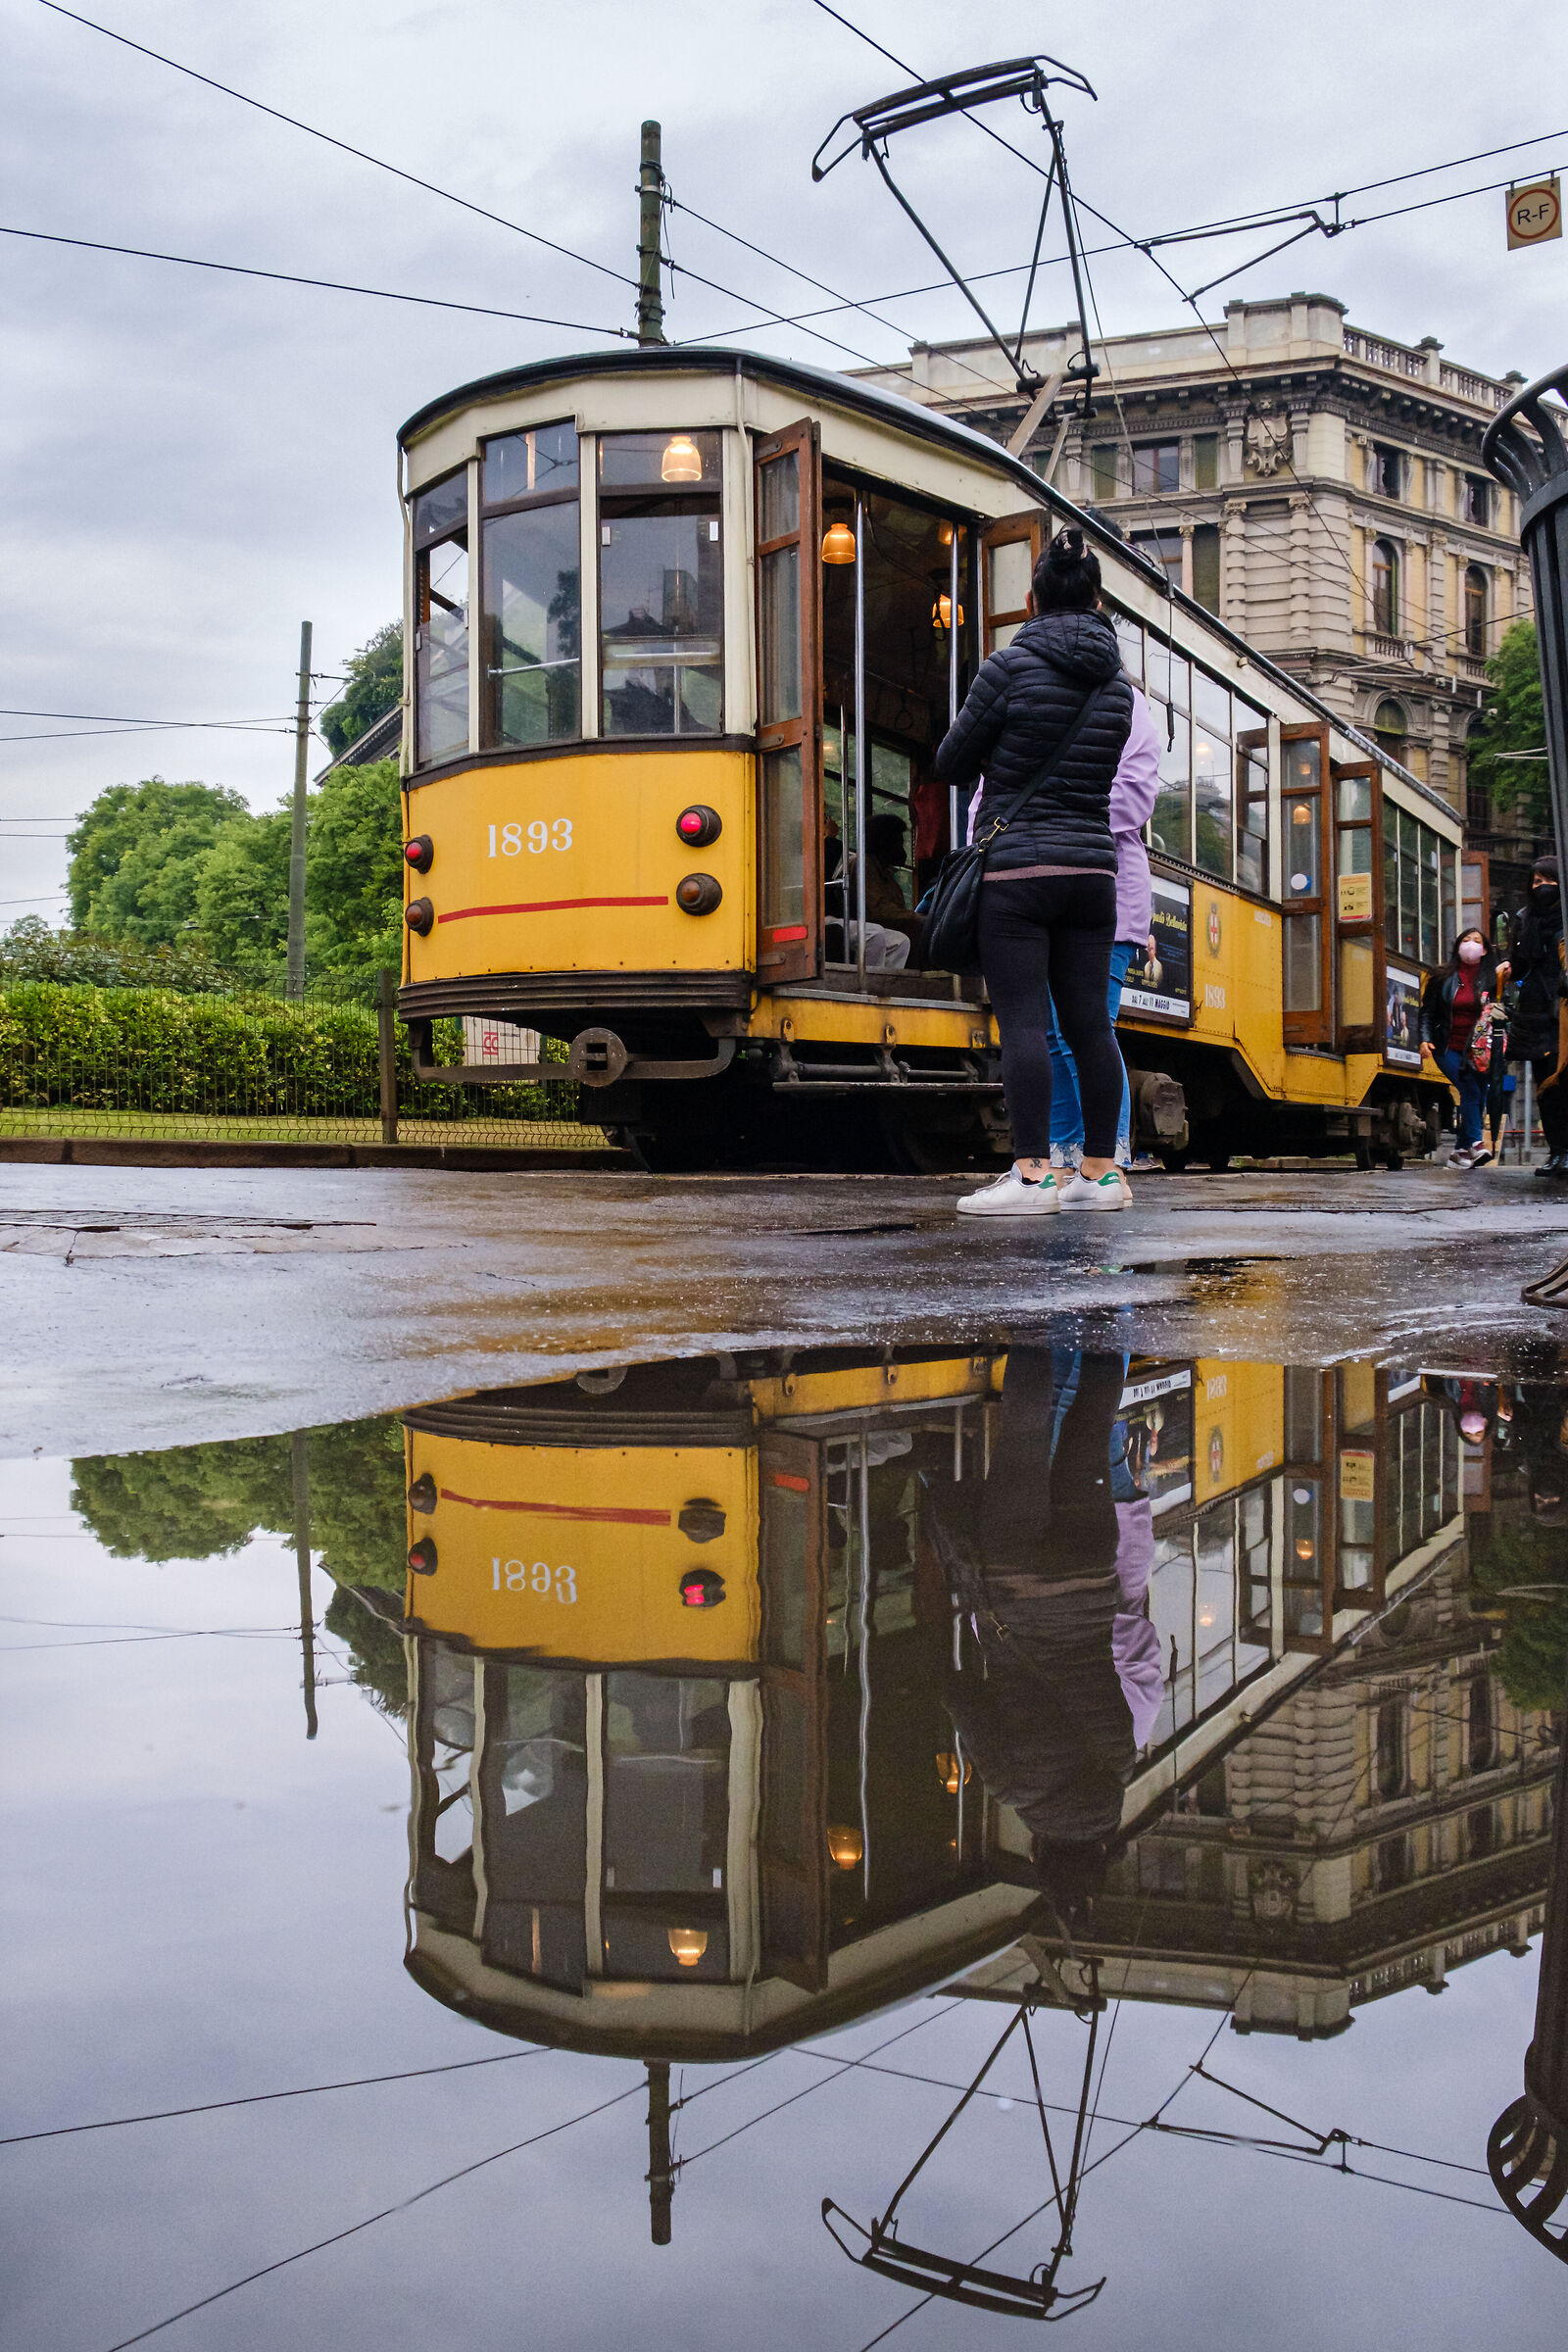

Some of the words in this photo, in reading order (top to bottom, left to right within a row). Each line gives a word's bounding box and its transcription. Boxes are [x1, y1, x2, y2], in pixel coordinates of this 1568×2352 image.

[1517, 203, 1550, 225] R-F
[487, 817, 573, 858] 1893
[1154, 998, 1170, 1010] MAGGIO
[1204, 983, 1225, 1009] 1893
